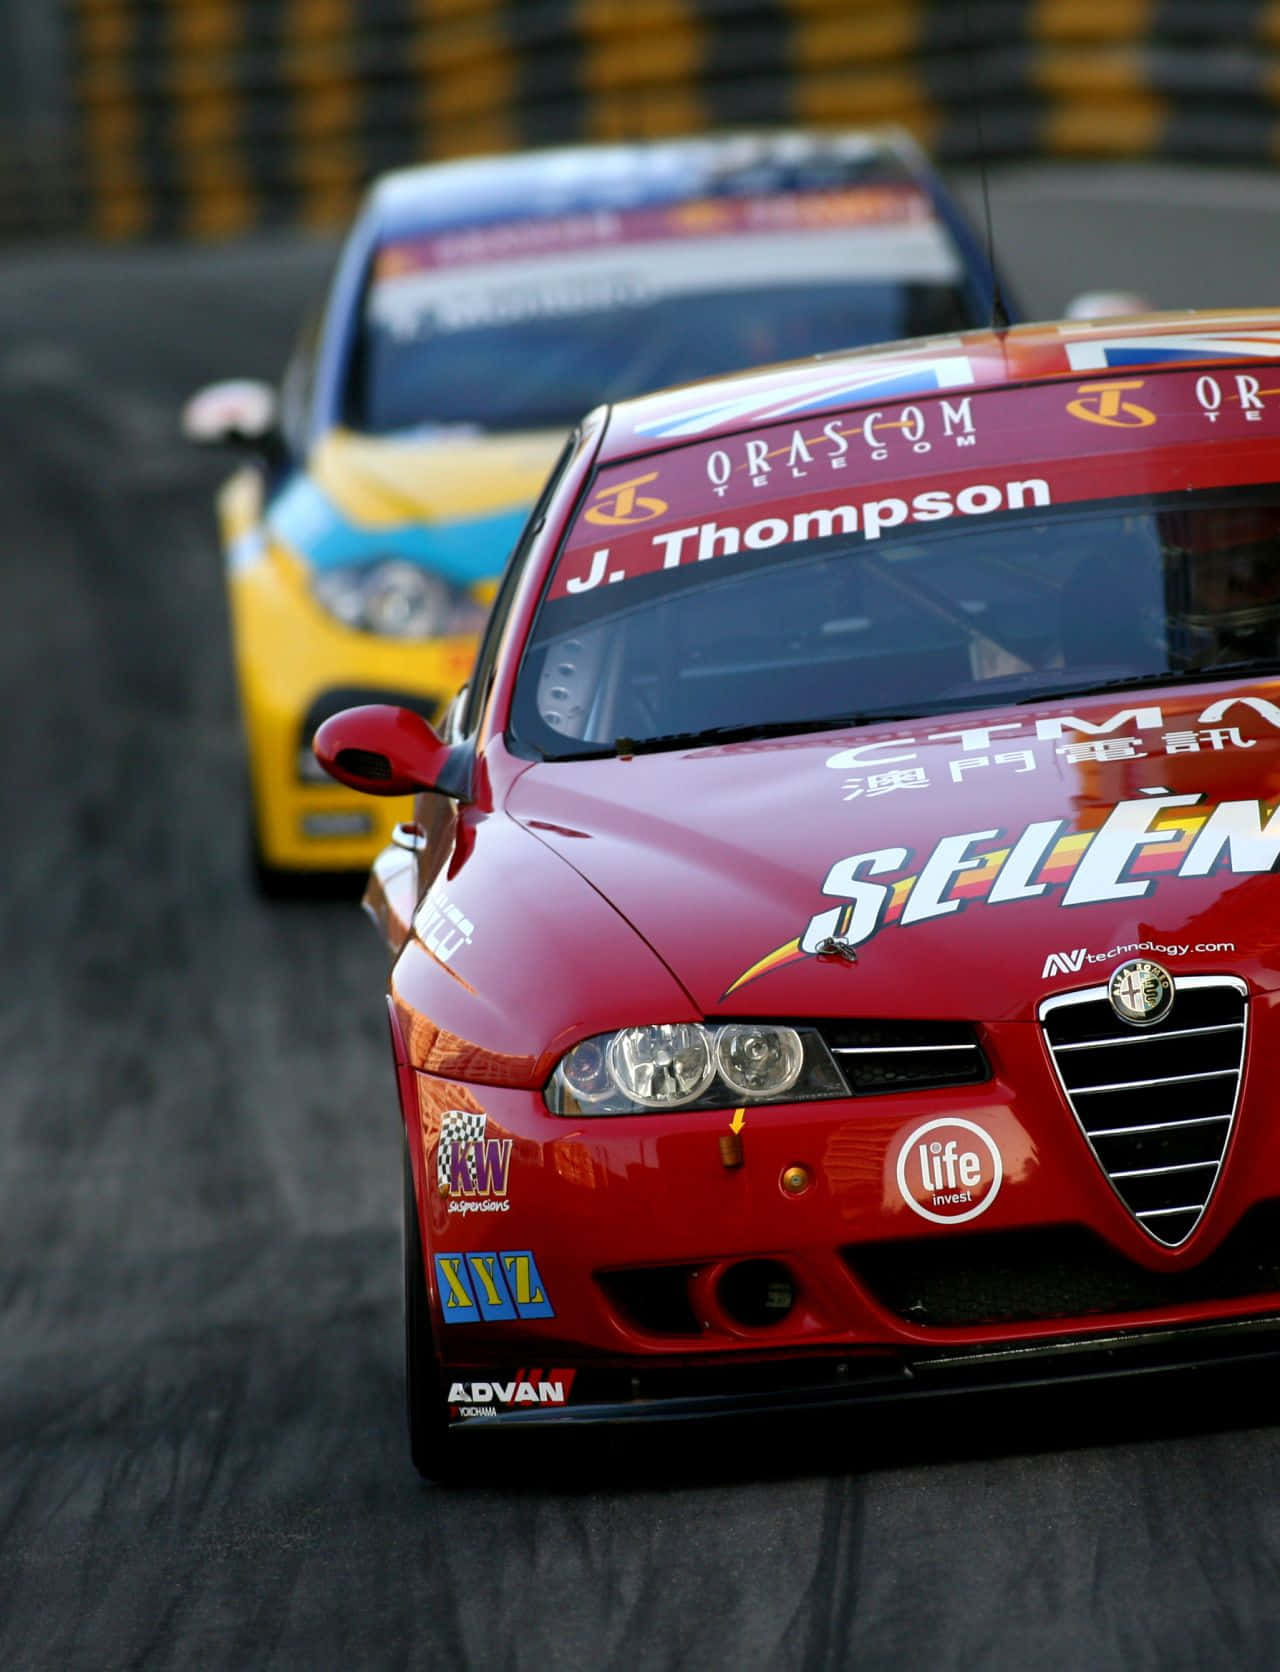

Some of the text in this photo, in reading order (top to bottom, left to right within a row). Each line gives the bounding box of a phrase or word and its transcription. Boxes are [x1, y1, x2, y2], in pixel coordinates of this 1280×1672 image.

[706, 397, 977, 486] ORASCOM
[713, 435, 977, 497] TELECOM
[565, 478, 1051, 594] J. Thompson
[449, 1138, 513, 1197] KW
[918, 1140, 982, 1192] life
[447, 1199, 511, 1218] suspensions
[932, 1191, 973, 1207] invest
[438, 1256, 544, 1308] XYZ
[447, 1382, 565, 1403] ADVAN
[458, 1406, 498, 1417] YOKOHAMA
